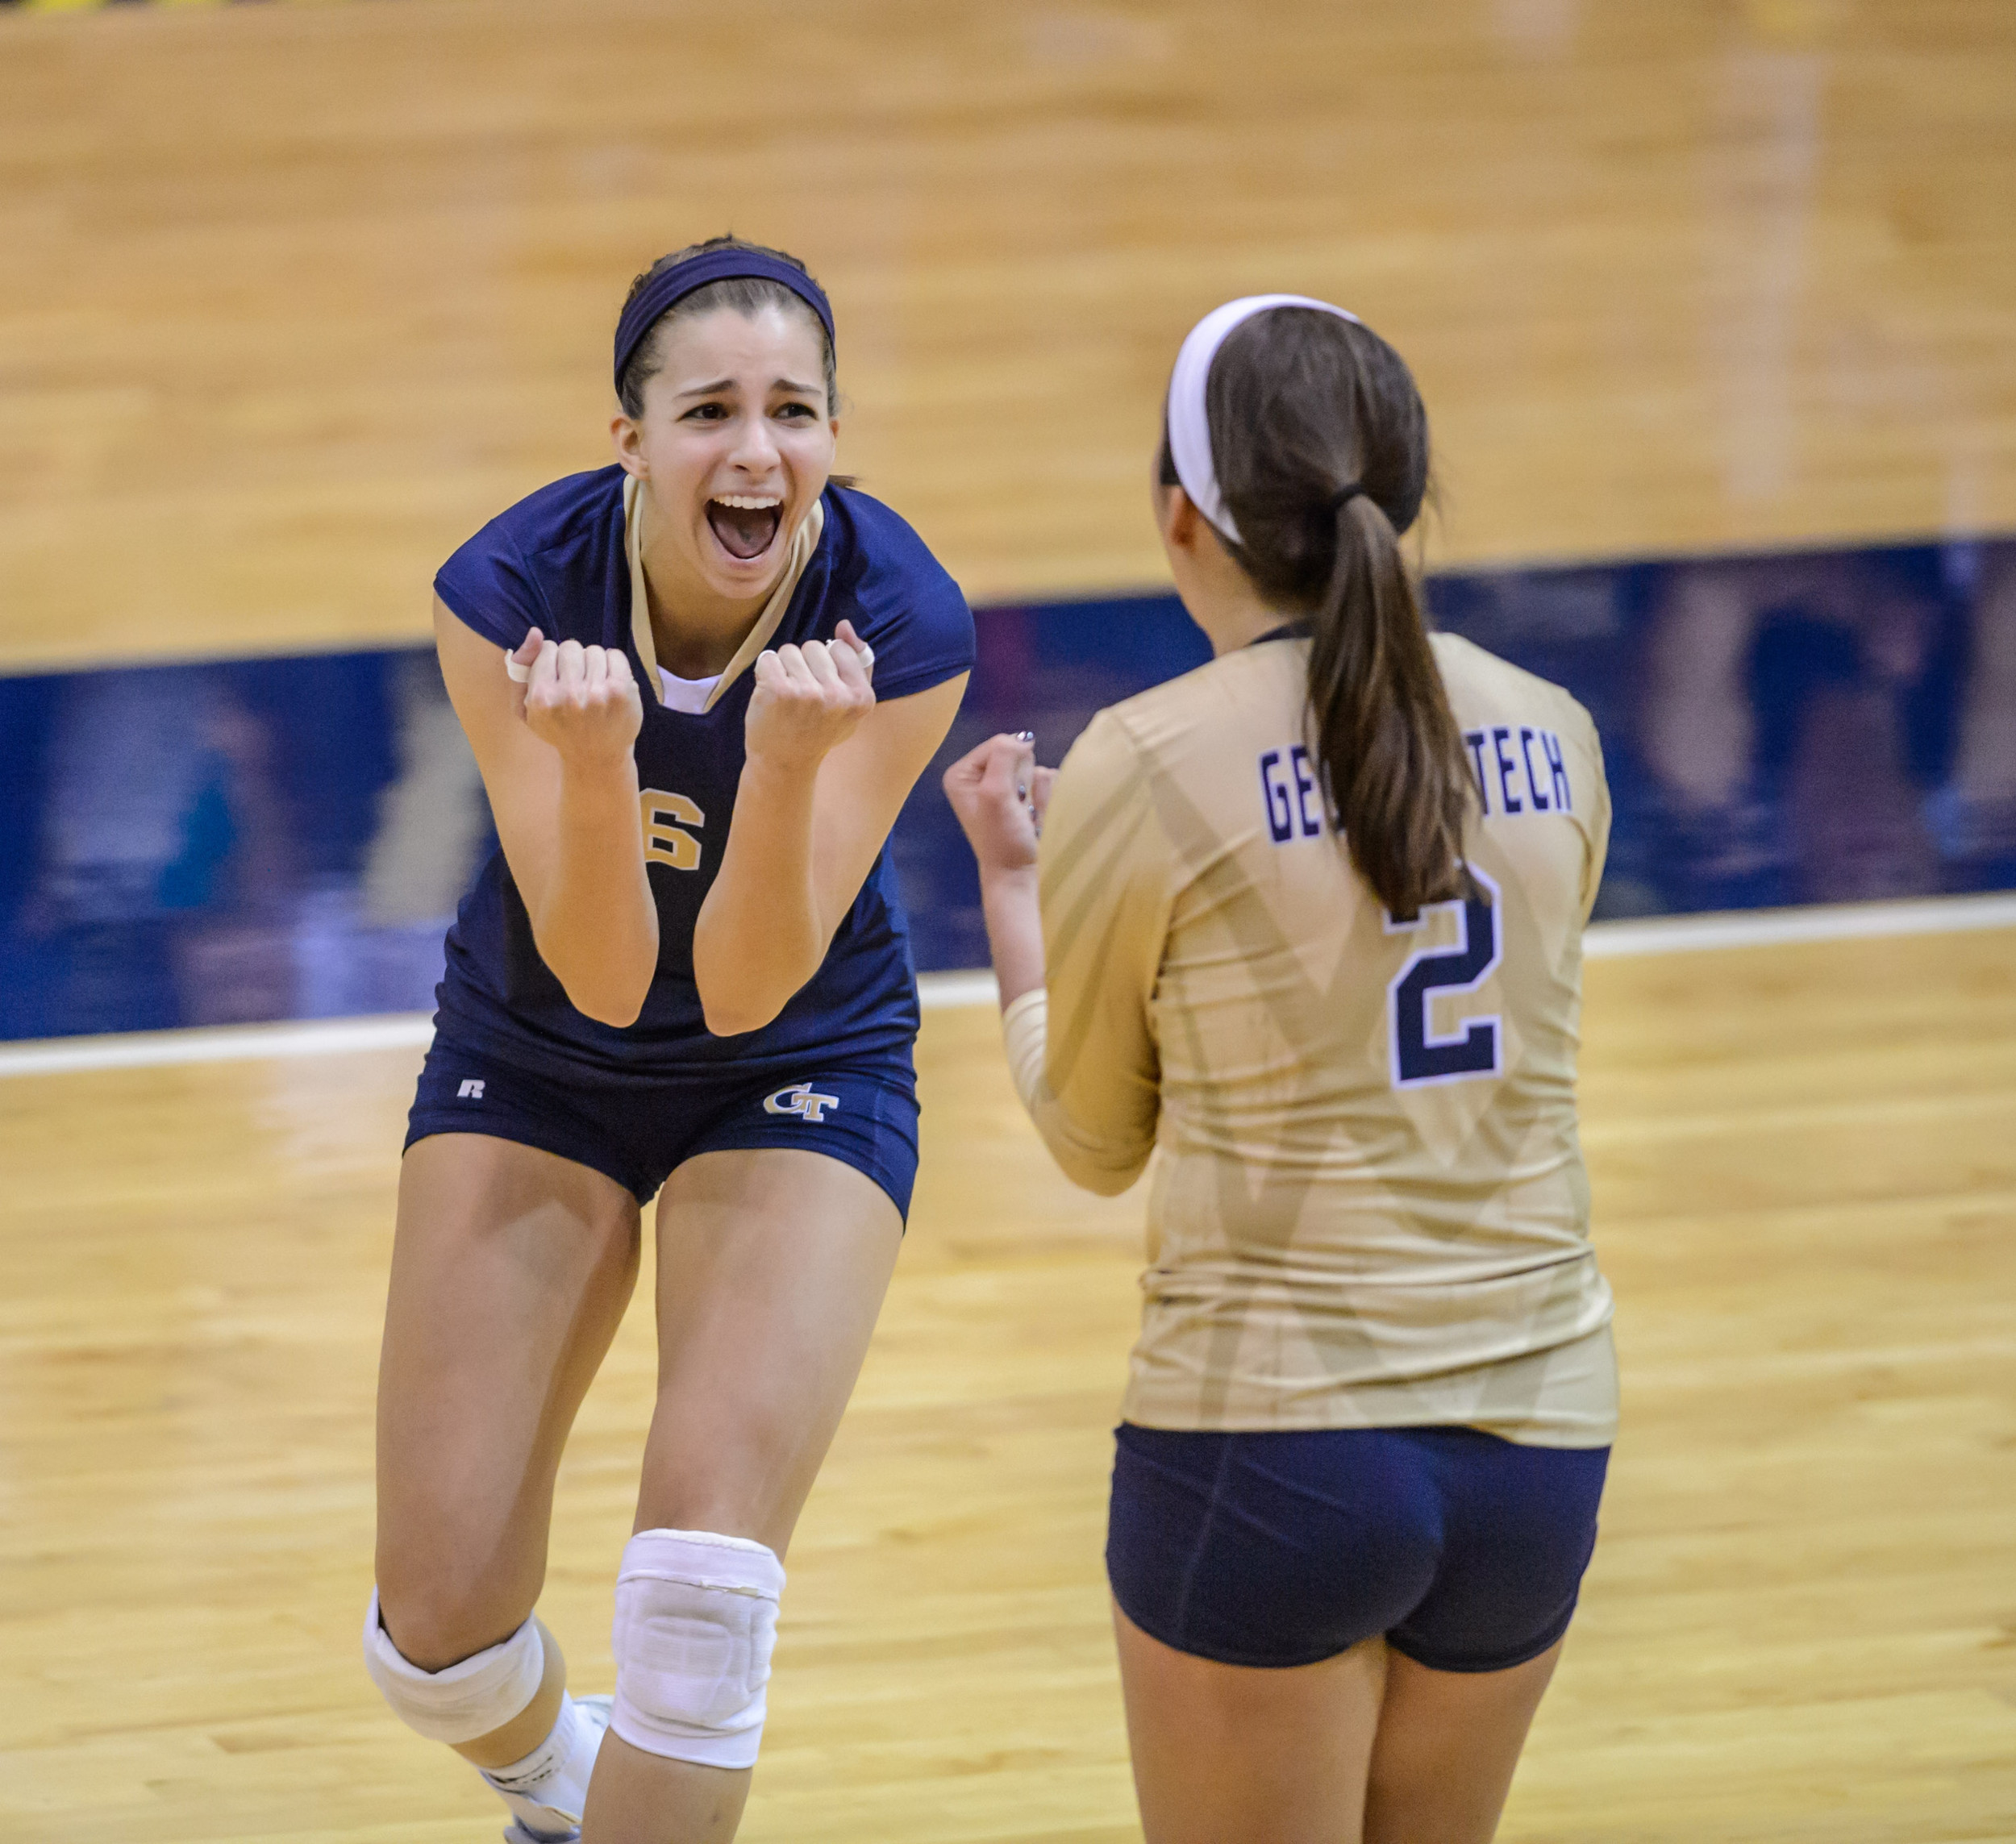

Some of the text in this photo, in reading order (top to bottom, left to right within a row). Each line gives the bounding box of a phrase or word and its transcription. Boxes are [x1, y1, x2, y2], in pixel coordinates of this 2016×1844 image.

[1464, 727, 1572, 817] TECH
[639, 788, 706, 871] 6
[1384, 860, 1502, 1091] 2
[456, 1079, 485, 1099] R
[763, 1082, 839, 1122] GT
